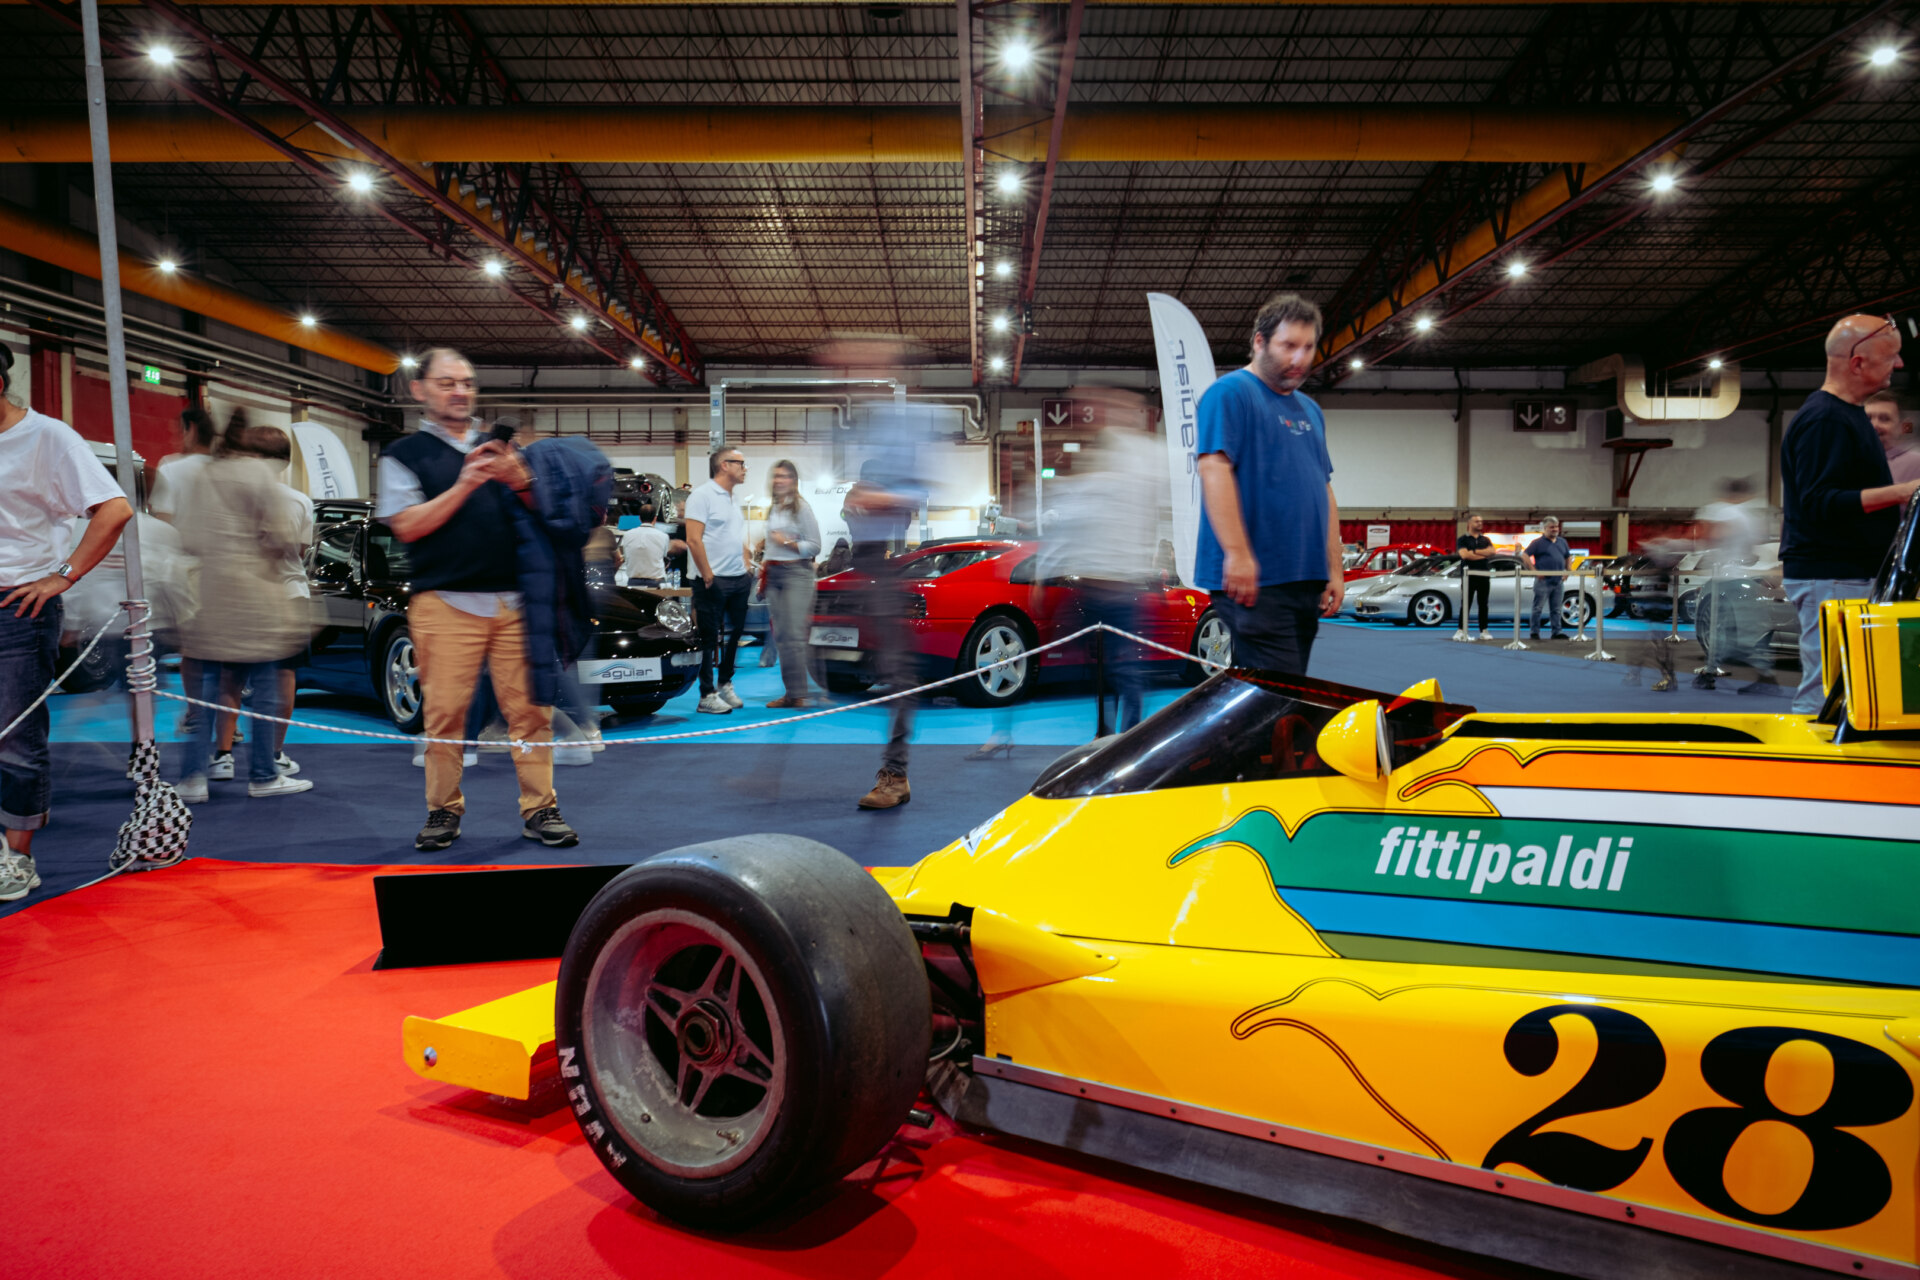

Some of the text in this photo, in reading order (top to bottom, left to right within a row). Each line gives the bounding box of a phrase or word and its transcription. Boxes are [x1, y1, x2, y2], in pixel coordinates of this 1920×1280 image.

[1082, 406, 1095, 423] 3
[1553, 406, 1567, 425] 3
[601, 668, 653, 680] aguiar
[1374, 826, 1635, 895] fittipaldi
[1480, 1003, 1915, 1232] 28
